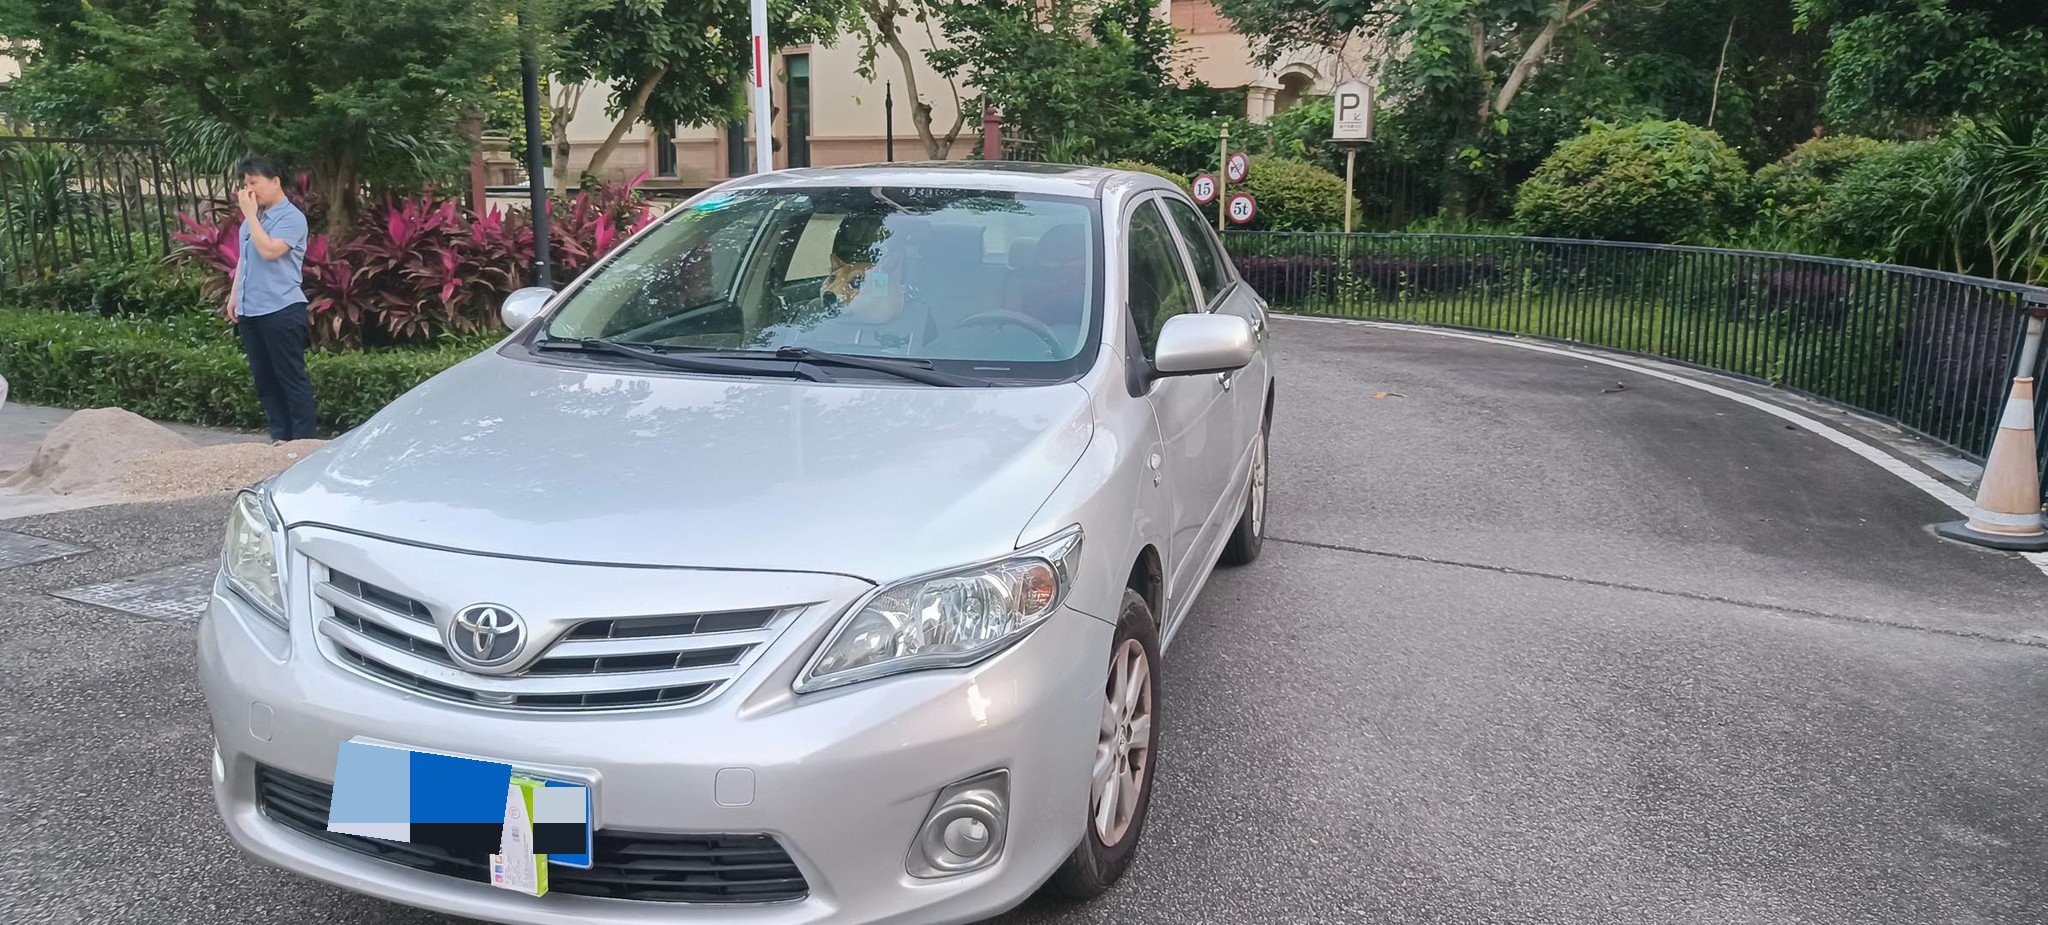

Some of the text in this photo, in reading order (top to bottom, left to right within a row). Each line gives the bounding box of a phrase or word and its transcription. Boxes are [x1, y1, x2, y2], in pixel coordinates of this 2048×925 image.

[1339, 93, 1360, 121] P
[1196, 182, 1211, 196] 15
[1233, 202, 1249, 215] 5t
